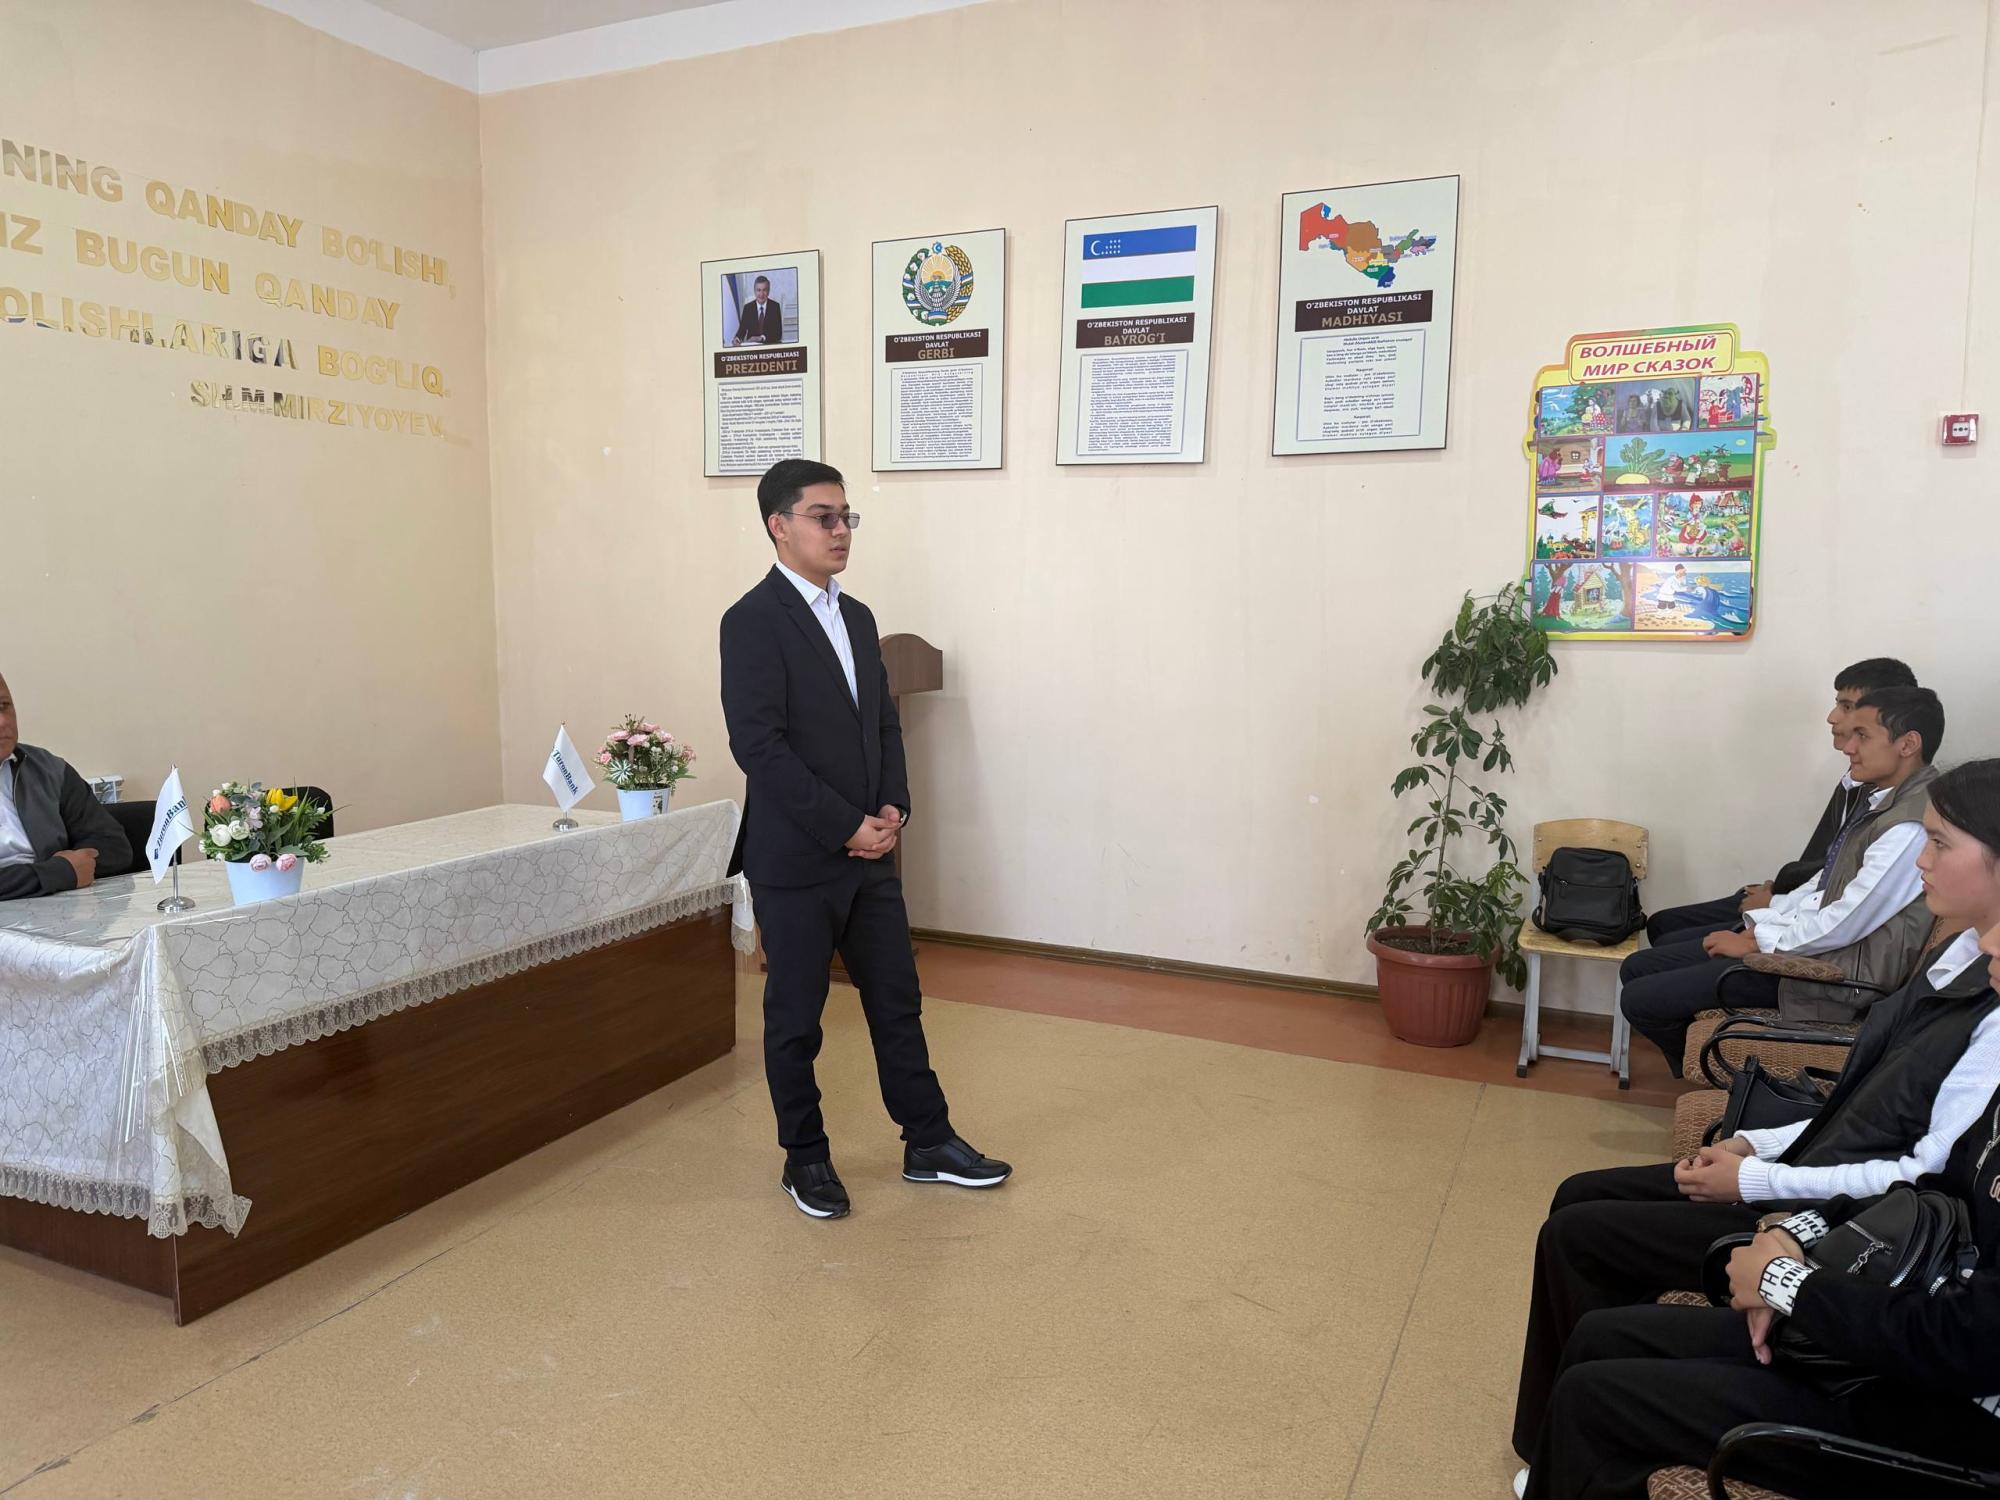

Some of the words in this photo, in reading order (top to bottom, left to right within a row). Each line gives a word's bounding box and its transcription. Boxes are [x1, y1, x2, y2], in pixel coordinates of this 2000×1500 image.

[145, 181, 303, 248] QANDAY
[76, 228, 230, 295] BUGUN
[255, 271, 401, 329] QANDAY
[1361, 294, 1422, 305] RESPUBLIKASI
[1346, 306, 1379, 315] DAVLAT
[1135, 316, 1187, 326] RESPUBLIKASI
[1321, 312, 1403, 328] MADHIYASI
[935, 331, 982, 341] RESPUBLIKASI
[1122, 327, 1150, 335] DAVLAT
[925, 341, 949, 349] DAVLAT
[1579, 335, 1717, 359] ВОЛШЕБНЫЙ
[918, 348, 955, 360] GERBI
[725, 360, 797, 375] PREZIDENTI
[1582, 363, 1629, 377] МИР
[1632, 356, 1717, 374] СКАЗОК
[551, 749, 579, 797] TuronBank
